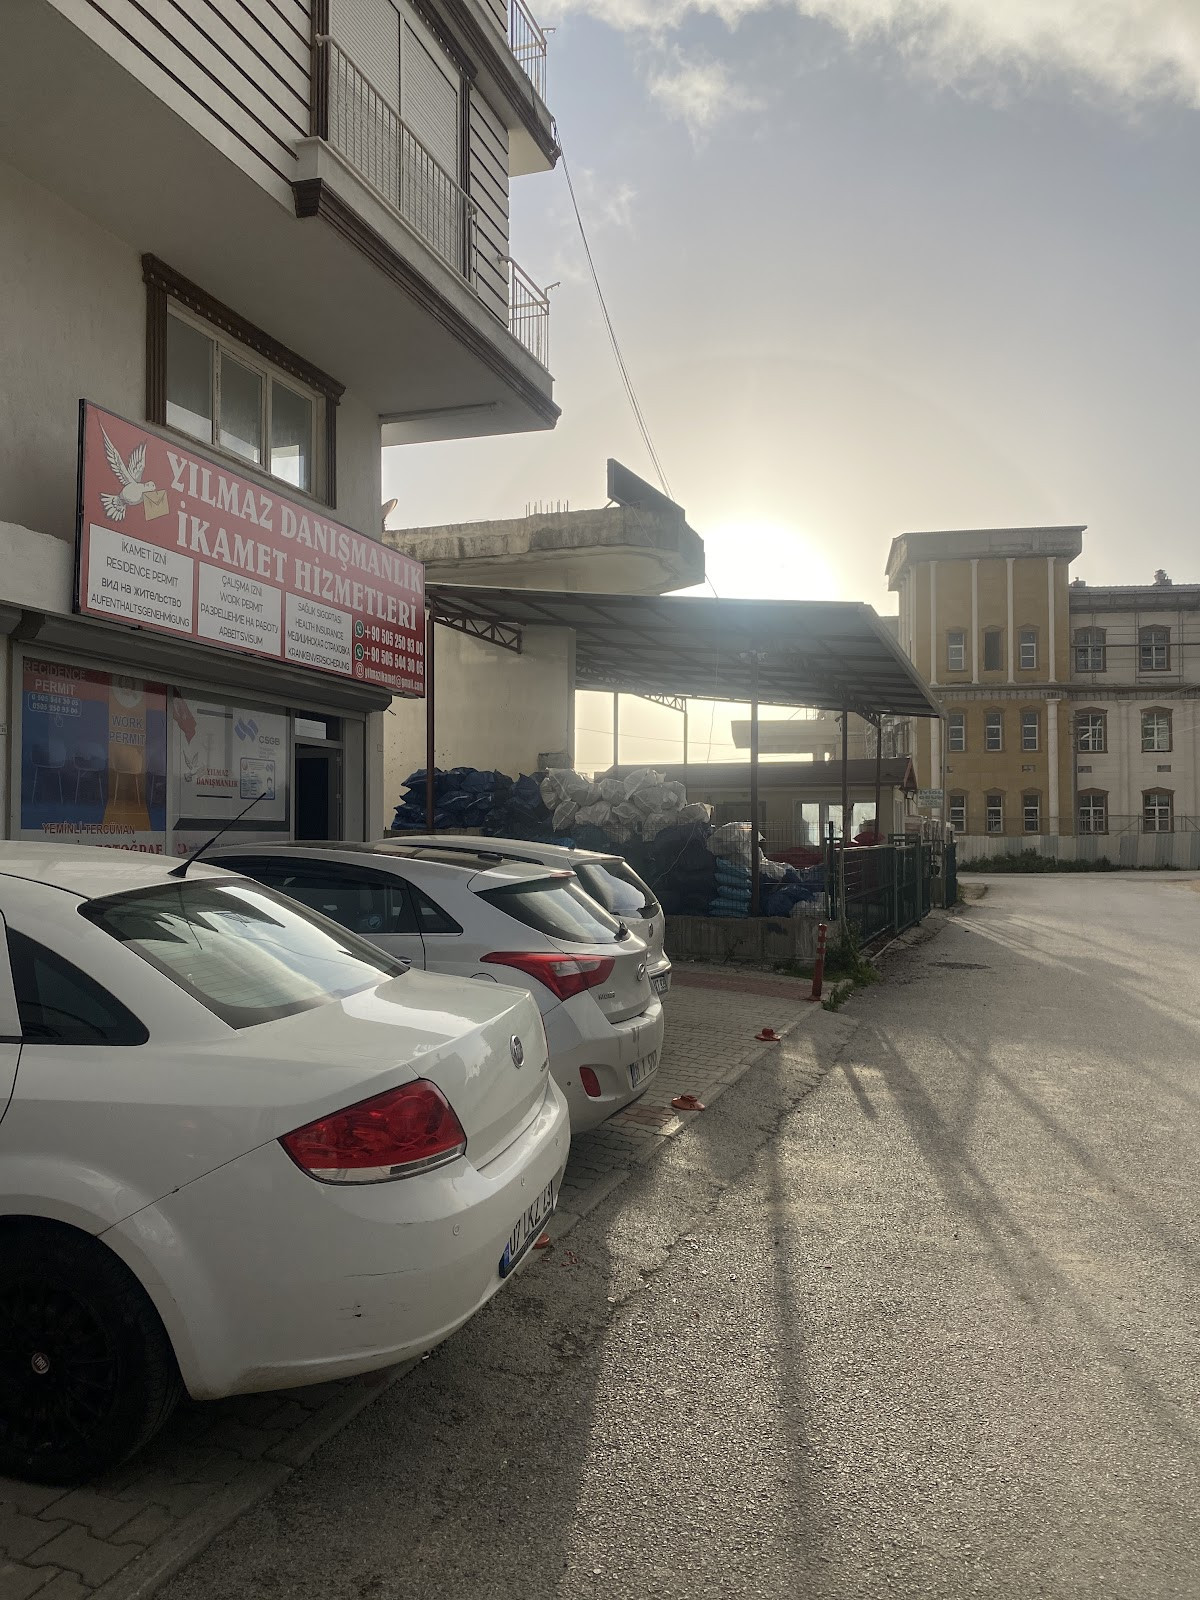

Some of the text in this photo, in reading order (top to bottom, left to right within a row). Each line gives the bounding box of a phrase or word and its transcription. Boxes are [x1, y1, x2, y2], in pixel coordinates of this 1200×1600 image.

[167, 450, 422, 594] YILMAZ DANIŞMANLIK
[122, 539, 151, 560] İKAMET
[177, 500, 417, 631] İKAMET HİZMETLERİ
[152, 571, 179, 587] PERMIT
[222, 575, 250, 592] ÇALIŞMA
[220, 590, 263, 613] WORK PERMIT
[365, 625, 380, 642] +90
[381, 628, 393, 646] 505
[364, 646, 380, 663] +90
[35, 678, 76, 696] PERMIT
[112, 715, 144, 729] WORK
[109, 730, 146, 746] PERMIT
